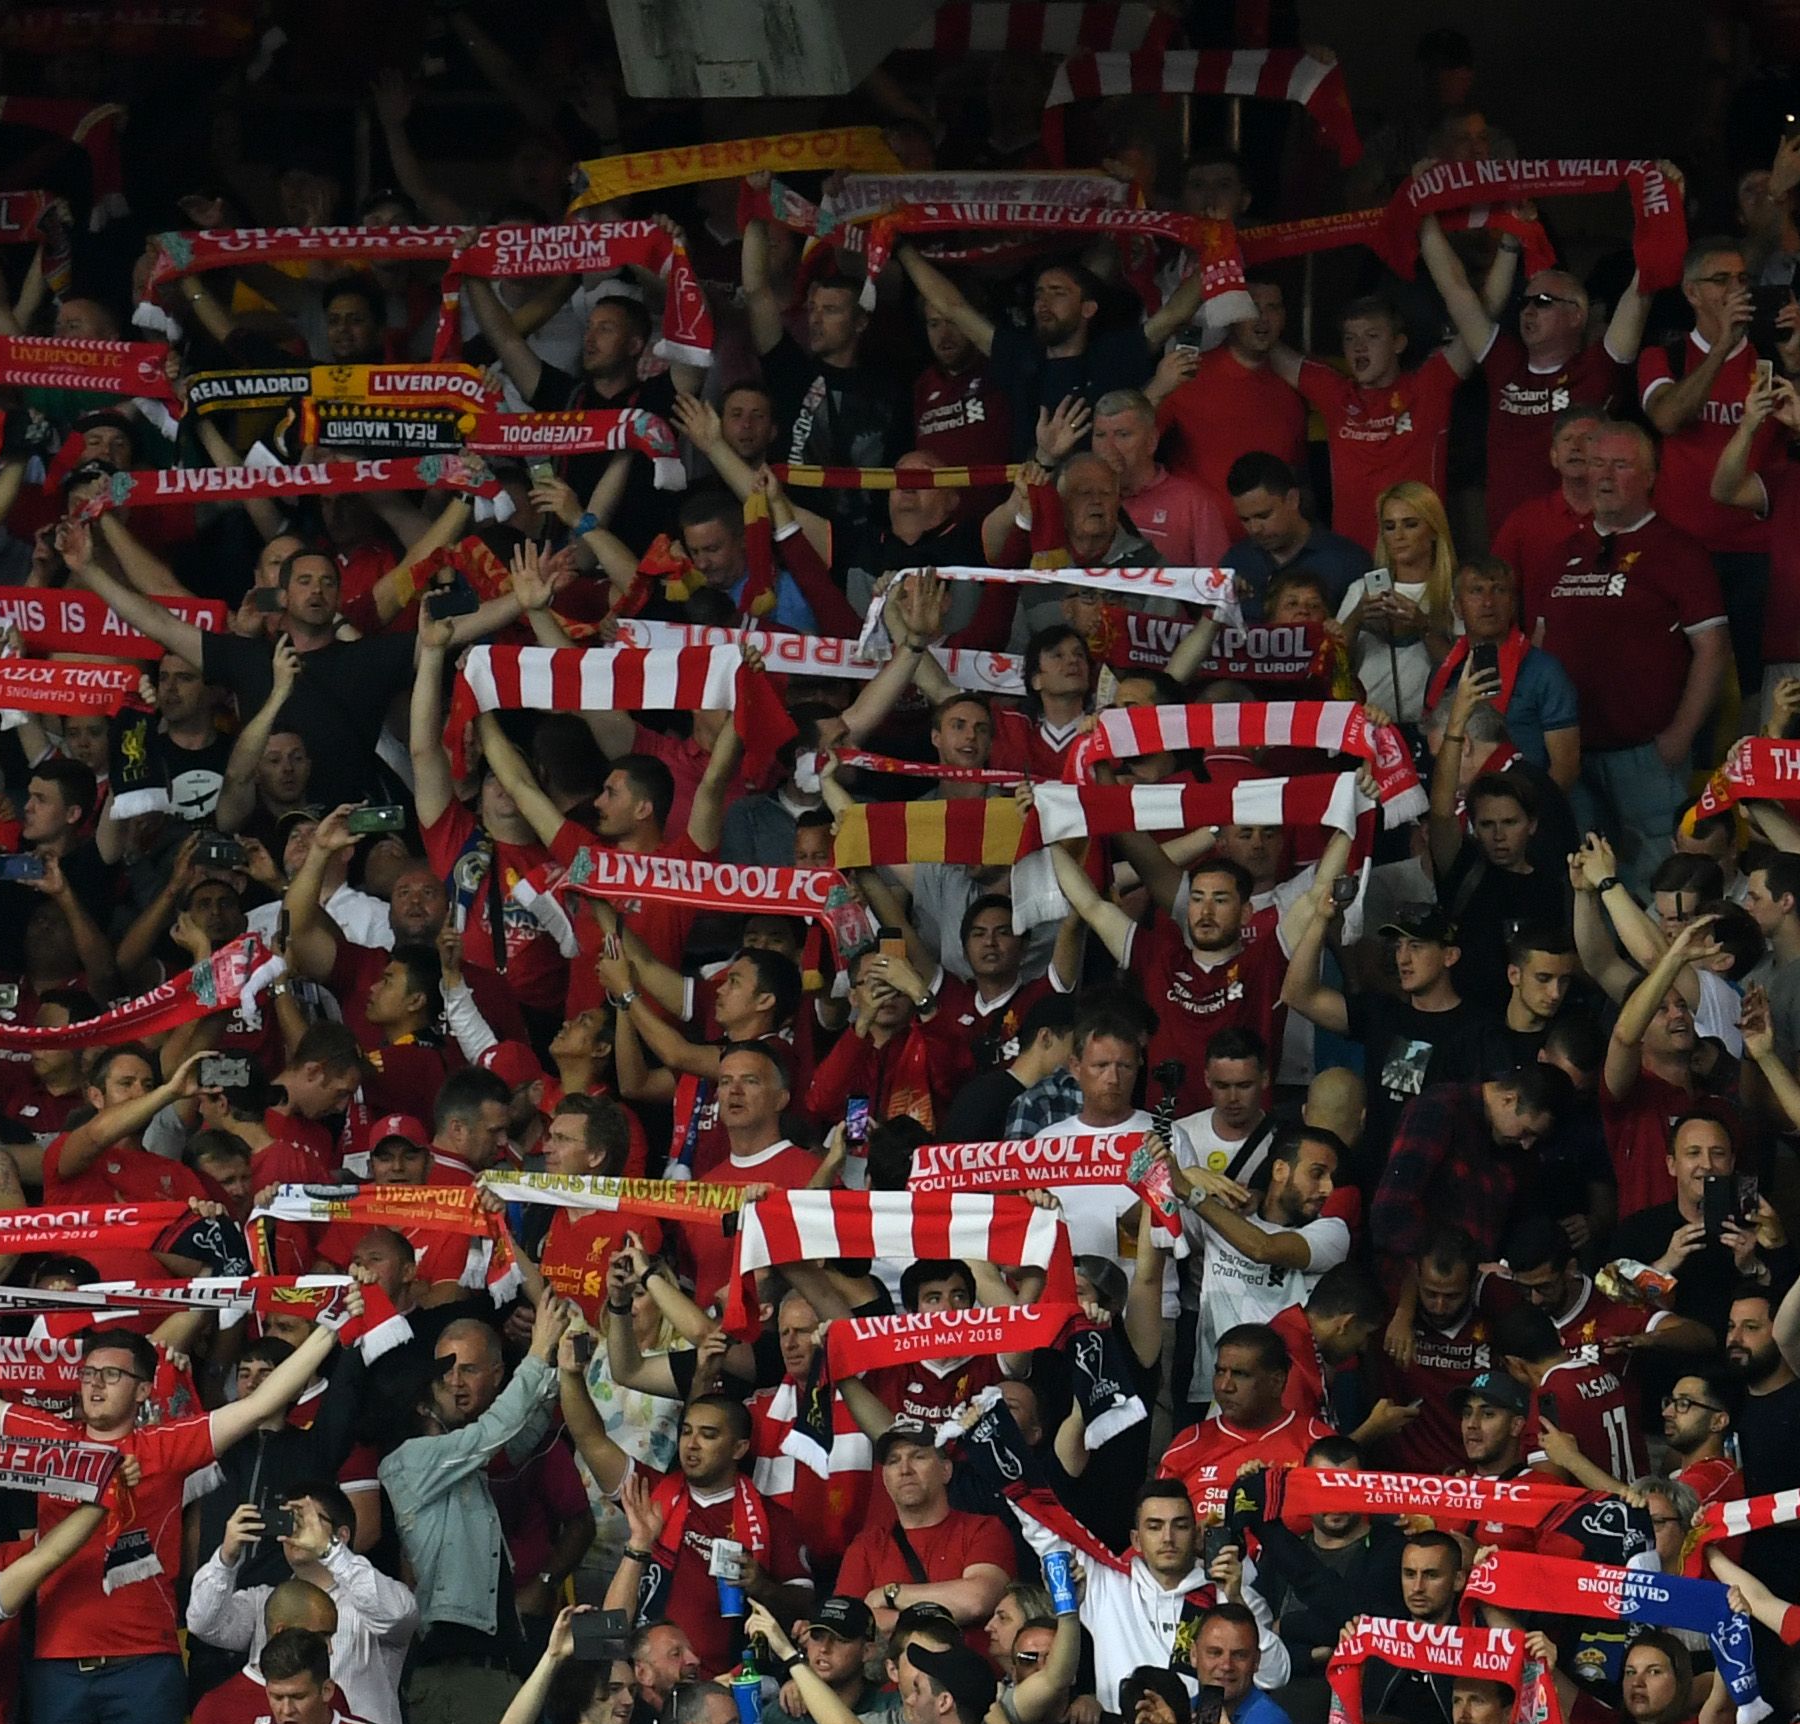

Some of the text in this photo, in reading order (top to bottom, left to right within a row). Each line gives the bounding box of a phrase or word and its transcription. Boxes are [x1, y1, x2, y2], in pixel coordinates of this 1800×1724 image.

[499, 222, 654, 247] OLIMPIYSKIY
[496, 240, 607, 264] STADIUM
[492, 255, 611, 277] 26TH MAY 2018
[190, 377, 310, 403] REAL MADRID
[373, 373, 487, 401] LIVERPOOL
[1559, 572, 1609, 585] Standard
[1551, 584, 1607, 599] Chartered
[1603, 1405, 1638, 1486] 11
[1596, 1566, 1656, 1585] LEAGUE
[1577, 1577, 1671, 1603] CHAMPIONS
